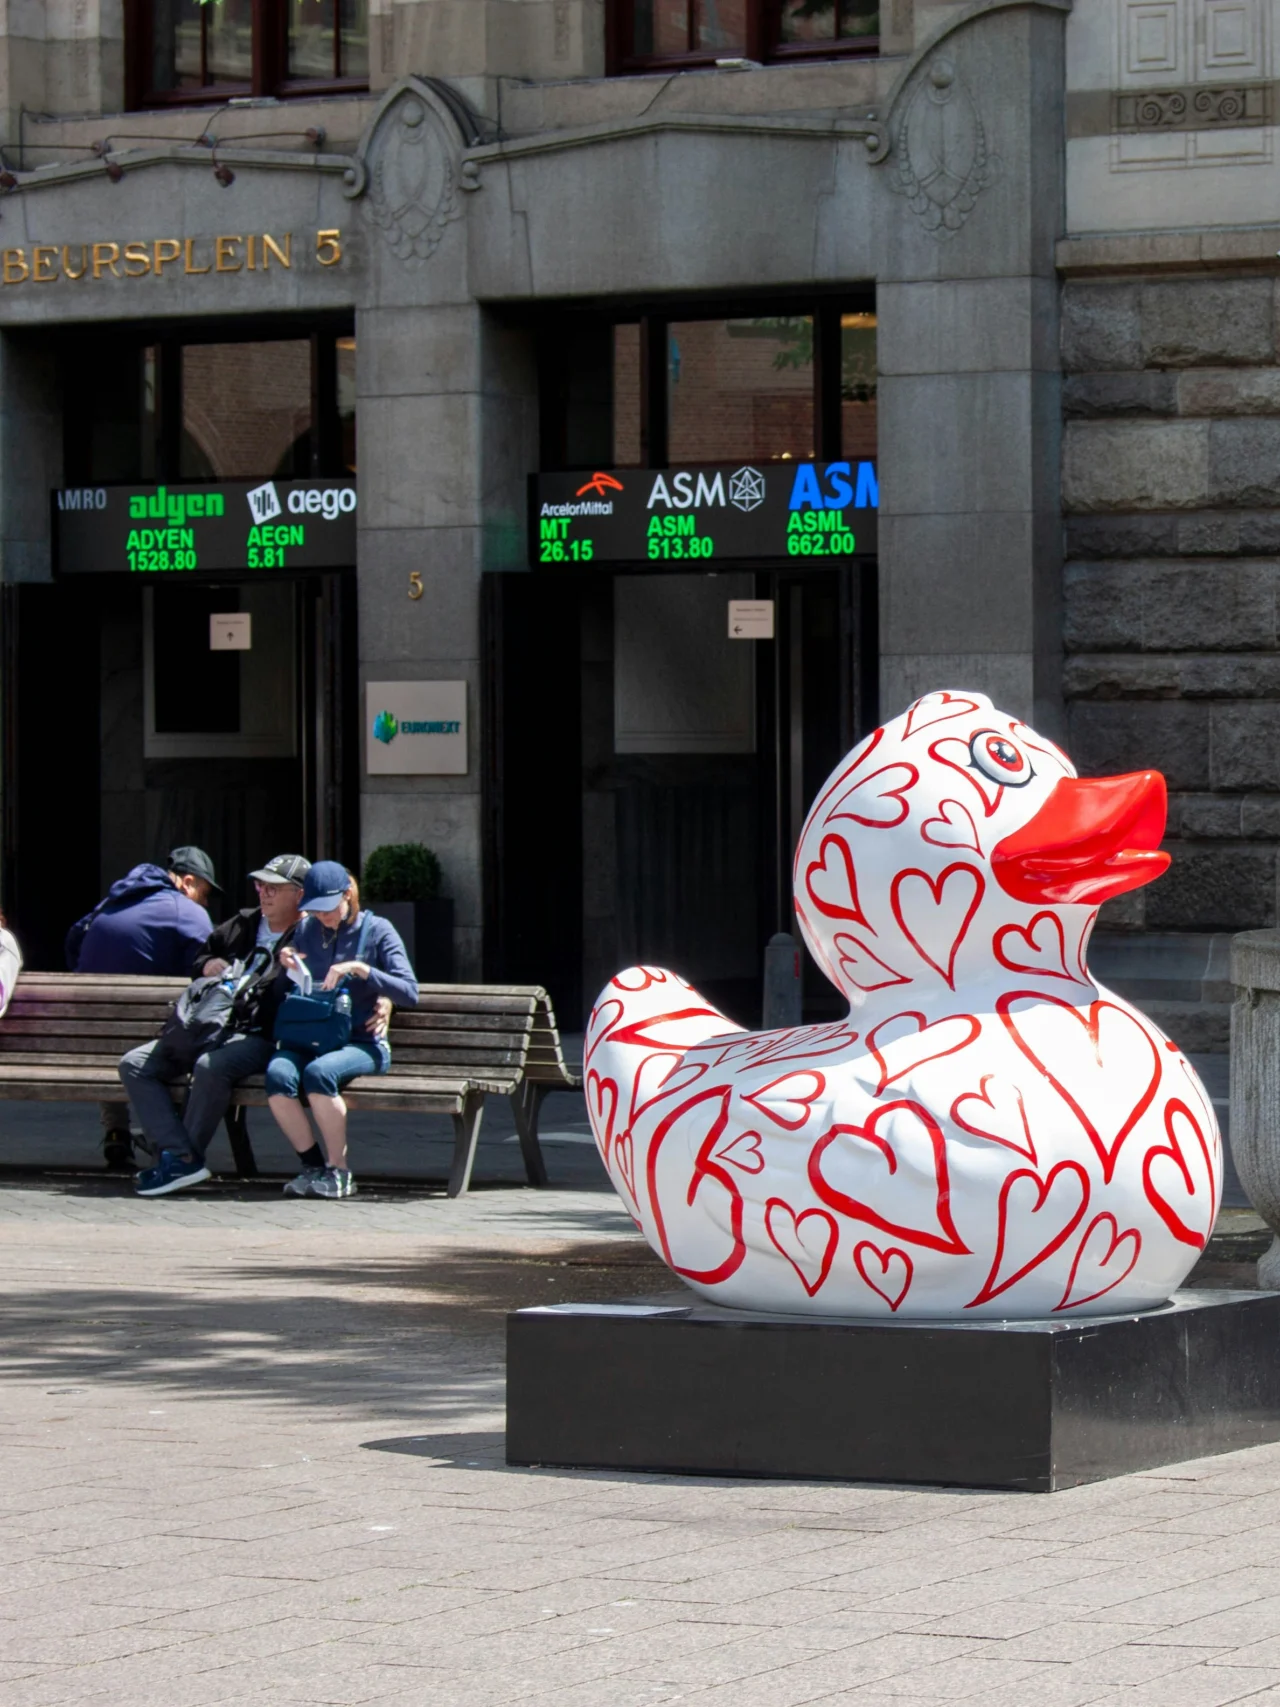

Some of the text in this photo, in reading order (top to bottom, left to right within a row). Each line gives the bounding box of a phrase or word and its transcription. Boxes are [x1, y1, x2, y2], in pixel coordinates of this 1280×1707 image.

[2, 228, 342, 284] BEURSPLEIN 5
[646, 471, 726, 509] ASM
[129, 485, 225, 526] adyen
[540, 501, 613, 517] ArcelorMittal
[540, 518, 571, 540] MT
[647, 514, 696, 538] ASM
[786, 509, 850, 534] ASML
[126, 528, 194, 551] ADYEN
[246, 524, 305, 548] AEGN
[647, 536, 714, 560] 513.80
[787, 532, 856, 556] 662.00
[127, 549, 197, 572] 1528.80
[247, 546, 285, 569] 5.81
[540, 539, 593, 563] 26.15
[408, 571, 424, 600] 5
